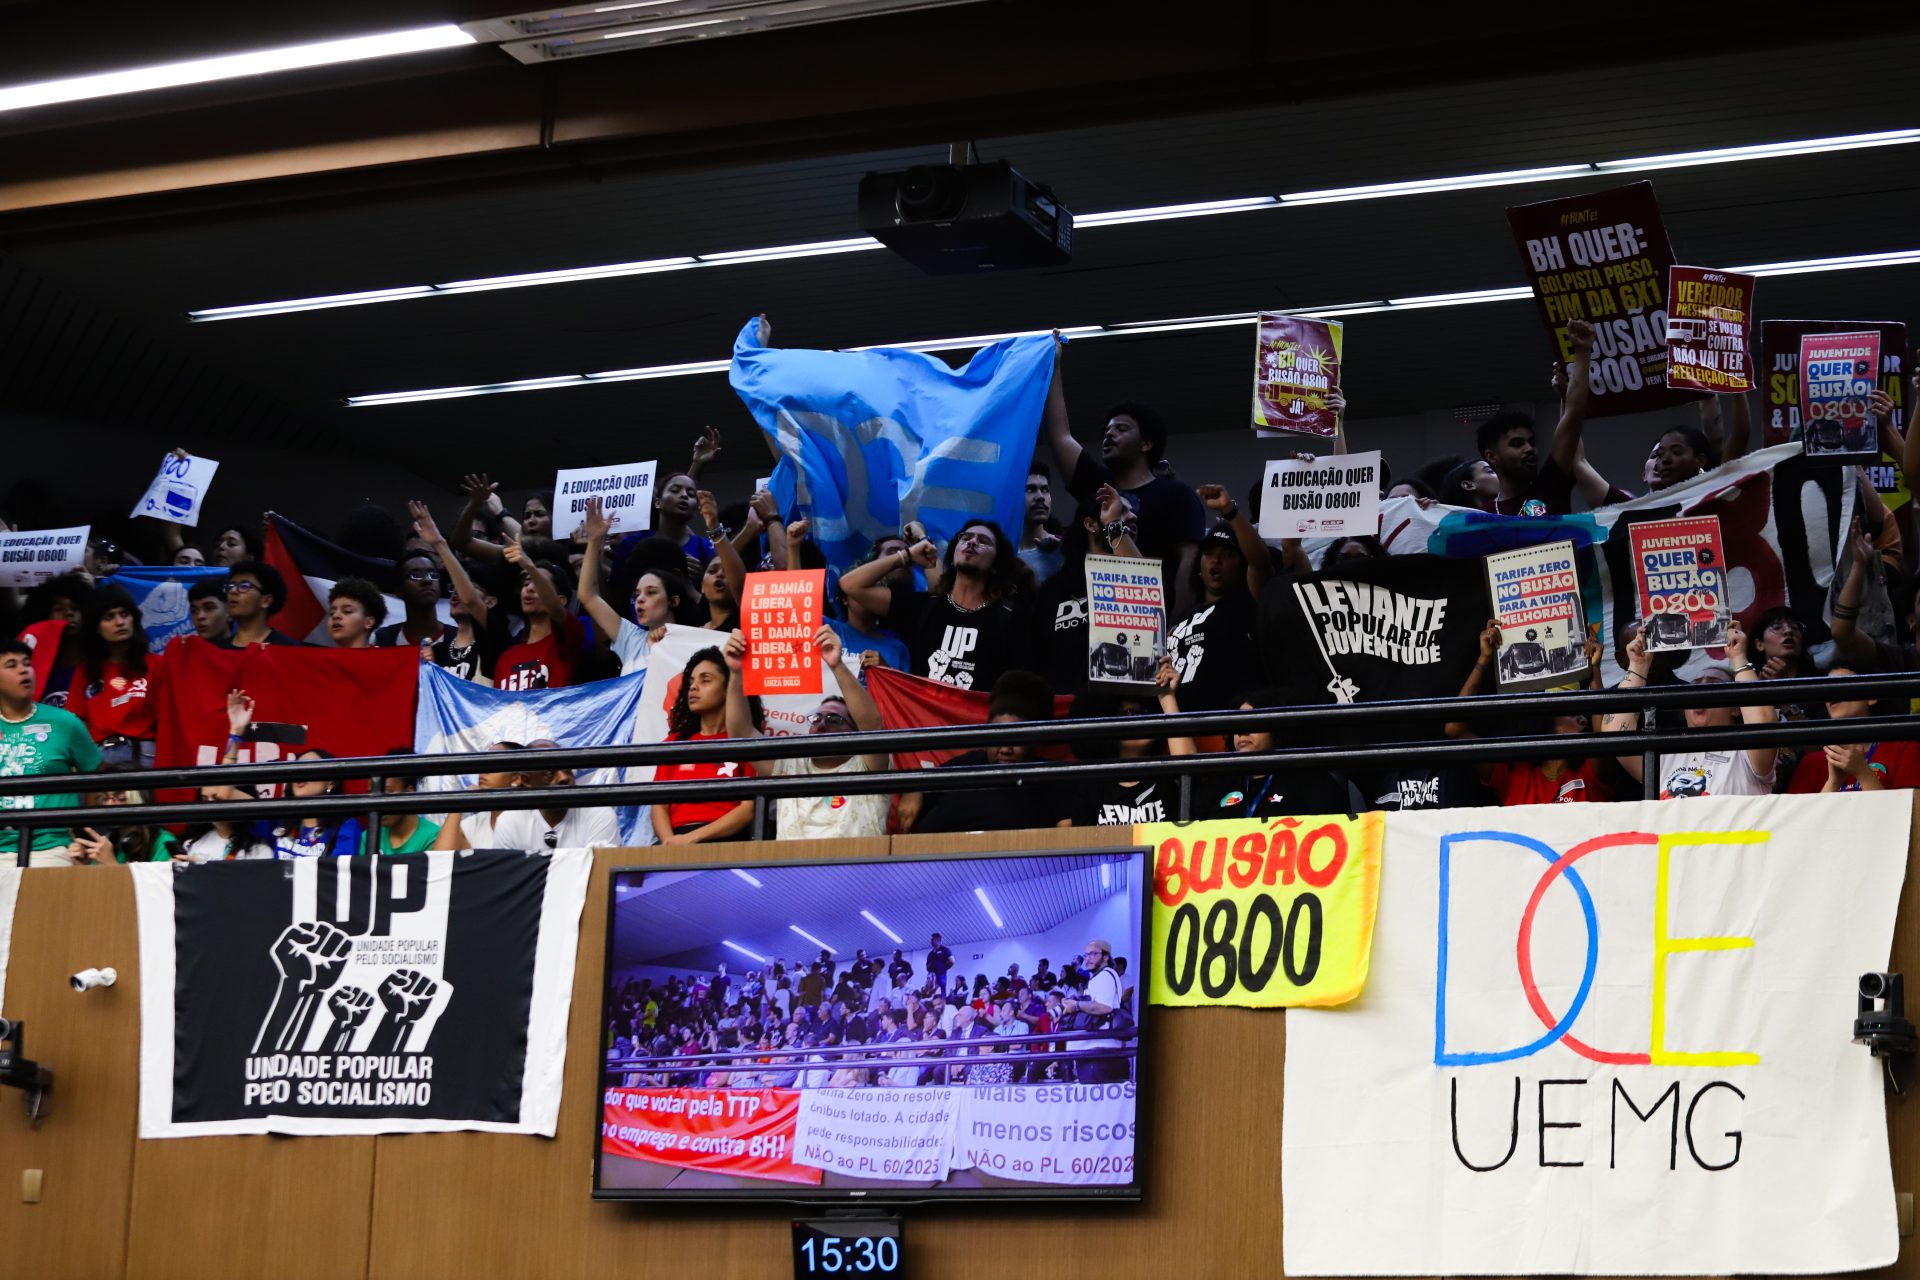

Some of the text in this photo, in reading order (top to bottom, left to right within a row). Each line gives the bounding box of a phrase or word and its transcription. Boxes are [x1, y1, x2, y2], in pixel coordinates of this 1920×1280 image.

[1526, 223, 1648, 272] BH QUER:
[1539, 258, 1659, 294] GOLPISTA PRESO,
[1544, 278, 1662, 322] FIM DA 6X1
[1678, 281, 1743, 309] VEREADOR
[1676, 303, 1706, 318] PRESTA
[1709, 320, 1743, 336] SE VOTAR
[1707, 335, 1744, 351] CONTRA
[1808, 347, 1871, 359] JUVENTUDE
[1278, 351, 1319, 373] BH QUER
[1673, 344, 1743, 370] NÃO VAI TER
[1268, 368, 1328, 389] BUSÃO 0800
[1567, 355, 1644, 396] 800
[1808, 362, 1852, 380] QUER
[1808, 380, 1866, 398] BUSÃO
[1289, 398, 1305, 415] JÁ!
[1810, 398, 1866, 420] 0800
[562, 474, 649, 495] A EDUCAÇÃO QUER
[1271, 467, 1374, 489] A EDUCAÇÃO QUER
[571, 493, 635, 513] BUS 0800!
[1283, 491, 1361, 510] BUSÃO 0800!
[3, 535, 81, 549] EDUCAÇÃO QUER
[1642, 533, 1712, 549] JUVENTUDE
[3, 549, 67, 562] BUSÃO 0800!
[1644, 550, 1696, 572] QUER
[1091, 571, 1158, 586] TARIFA ZERO
[1495, 560, 1571, 582] TARIFA ZERO
[1647, 569, 1717, 592] BUSÃO
[753, 579, 813, 595] EI DAMIÃO
[1093, 585, 1161, 601] NO BUSÃO
[1497, 573, 1574, 599] NO BUSÃO
[751, 597, 812, 609] LIBERA O
[1094, 601, 1157, 615] PARA A VIDA
[1301, 580, 1448, 632] LEVANTE
[1499, 593, 1568, 613] PARA A VIDA
[1650, 588, 1718, 614] 0800
[1095, 613, 1158, 628] MELHORAR!
[1500, 604, 1573, 626] MELHORAR!
[751, 624, 811, 639] EI DAMIÃO
[1054, 621, 1079, 632] PUC
[1315, 610, 1437, 647] POPULAR DA
[751, 642, 811, 654] LIBERA O
[940, 625, 978, 660] UP
[1324, 631, 1441, 665] JUVENTUDE
[1154, 816, 1348, 907] BUSÃO
[317, 854, 428, 936] UP
[356, 940, 439, 952] UNIDADE POPULAR
[1165, 892, 1323, 999] 0800
[1434, 830, 1771, 1067] DCE
[356, 953, 438, 965] PELO SOCIALISMO
[245, 1054, 433, 1080] UNDADE POPULAR
[297, 1082, 431, 1106] SOCIALISMO
[847, 1088, 873, 1102] Zero
[877, 1091, 899, 1103] não
[903, 1089, 951, 1101] resolve
[1035, 1083, 1136, 1103] estudos
[626, 1093, 648, 1111] que
[651, 1095, 688, 1116] votar
[688, 1095, 723, 1119] pela
[727, 1093, 760, 1117] TTP
[850, 1109, 890, 1124] lotado.
[895, 1112, 904, 1123] A
[908, 1109, 950, 1123] cidade
[808, 1126, 832, 1139] pede
[972, 1120, 1052, 1141] menos
[1451, 1076, 1746, 1172] UEMG
[607, 1124, 617, 1138] o
[618, 1126, 678, 1151] emprego
[678, 1135, 690, 1150] e
[691, 1136, 745, 1155] contra
[749, 1135, 785, 1159] BH!
[804, 1143, 939, 1175] NÃO ao PL 60/2025
[967, 1149, 1006, 1169] NÃO
[1012, 1159, 1033, 1172] ao
[1040, 1157, 1064, 1174] PL
[801, 1236, 899, 1272] 15:30
